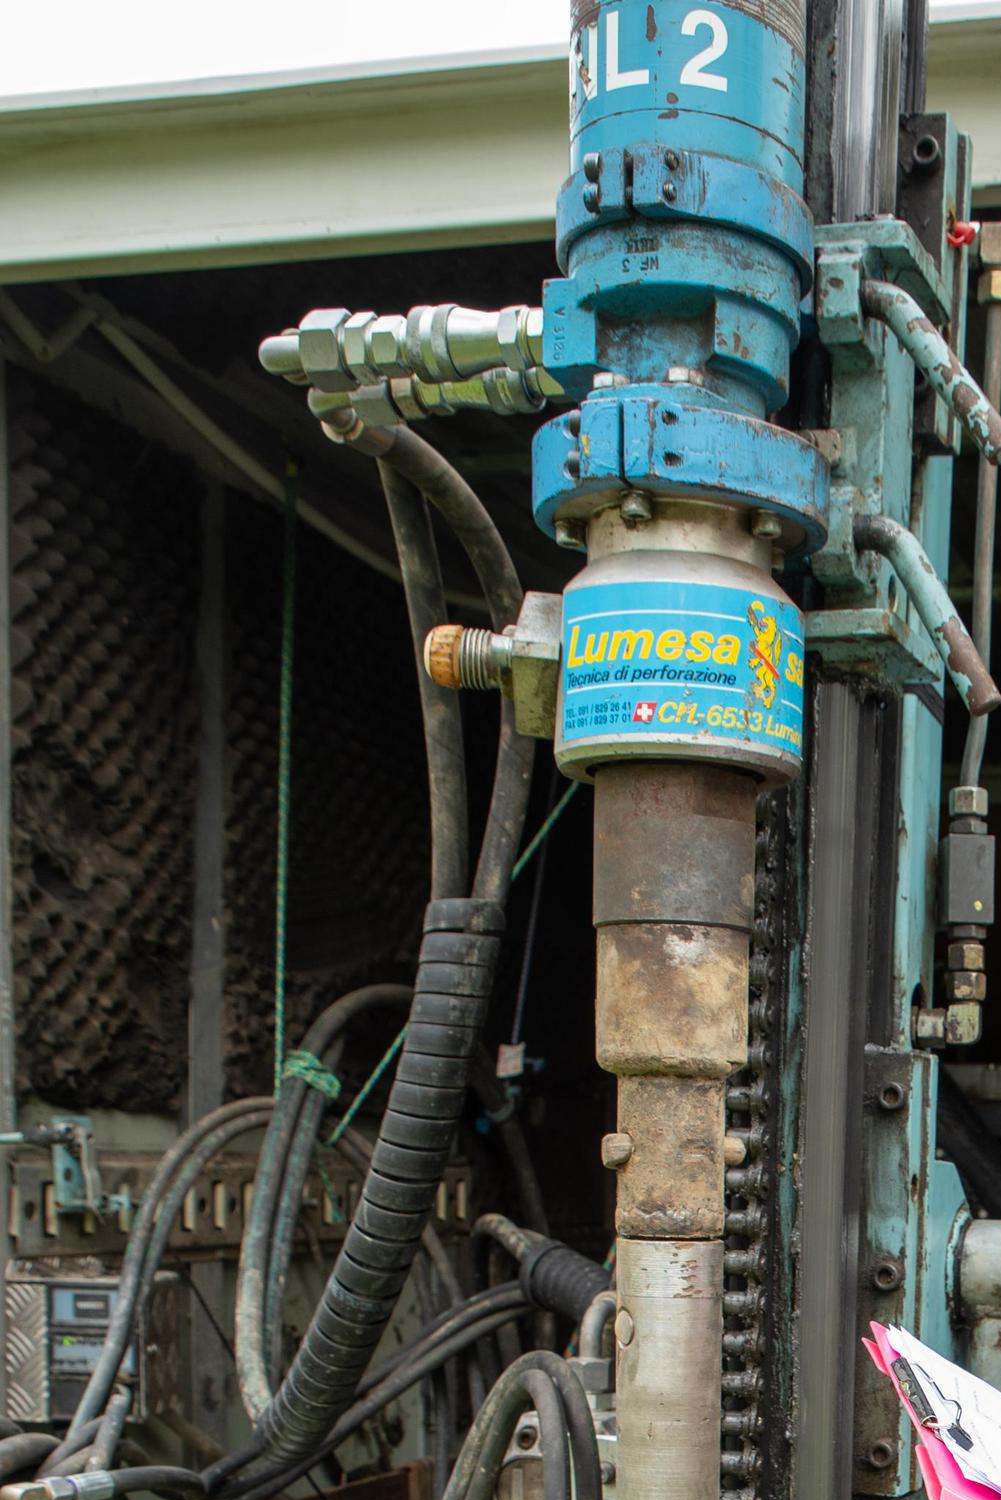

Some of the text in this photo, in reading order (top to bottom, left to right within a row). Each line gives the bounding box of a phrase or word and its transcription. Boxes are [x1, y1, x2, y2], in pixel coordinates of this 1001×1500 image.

[680, 9, 728, 93] 2
[567, 625, 741, 669] Lumesa
[567, 664, 737, 689] Tecnica di perforazione
[593, 714, 608, 726] 829
[610, 713, 620, 724] 37
[621, 712, 632, 723] 01
[594, 703, 609, 714] 829
[610, 702, 620, 713] 26
[621, 701, 632, 711] 41
